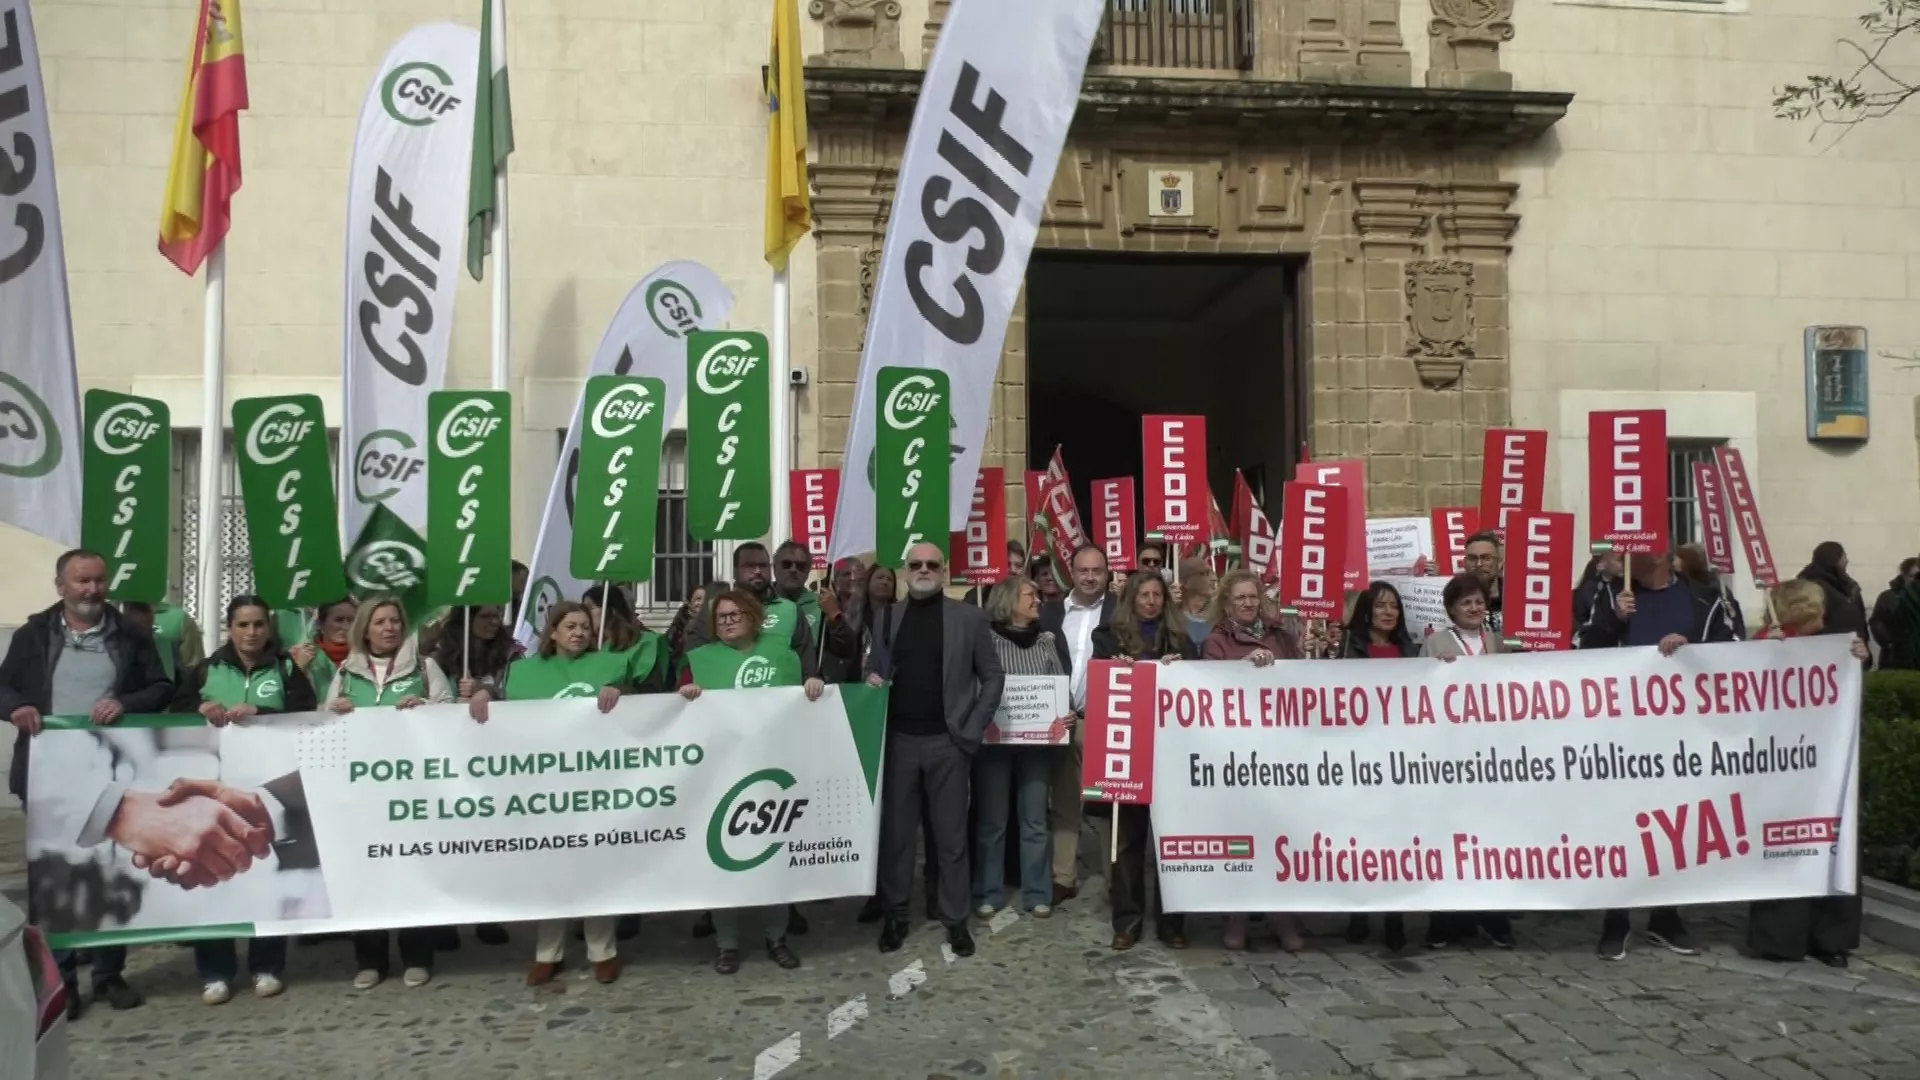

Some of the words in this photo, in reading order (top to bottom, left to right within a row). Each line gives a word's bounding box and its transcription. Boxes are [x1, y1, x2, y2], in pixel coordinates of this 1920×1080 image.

[397, 77, 461, 115] CSIF
[904, 60, 1033, 345] CSIF
[359, 165, 442, 386] CSIF
[708, 356, 759, 377] CSIF
[604, 399, 655, 420] CSIF
[895, 391, 942, 412] CSIF
[107, 417, 160, 441] CSIF
[259, 420, 314, 445] CSIF
[450, 417, 501, 438] CSIF
[359, 450, 424, 482] CSIF
[714, 402, 742, 532] CSIF
[1163, 421, 1187, 522] CCOO
[1614, 417, 1641, 530] CCOO
[596, 446, 633, 571] CSIF
[805, 473, 827, 554] CCOO
[1104, 483, 1122, 558] CCOO
[1701, 469, 1725, 556] CCOO
[1725, 455, 1767, 566] CCOO
[109, 465, 141, 591] CSIF
[276, 470, 312, 600] CSIF
[455, 465, 483, 596] CSIF
[1301, 489, 1326, 598] CCOO
[1604, 532, 1657, 541] universidad
[1525, 518, 1551, 628] CCOO
[1291, 599, 1335, 608] universidad
[1514, 630, 1562, 639] universidad
[743, 667, 776, 685] CSIF
[1156, 688, 1215, 727] POR
[1223, 688, 1251, 727] EL
[1260, 686, 1369, 727] EMPLEO
[1376, 686, 1392, 725] Y
[1401, 685, 1436, 725] LA
[1443, 679, 1571, 723] CALIDAD
[1581, 676, 1621, 718] DE
[1631, 673, 1686, 717] LOS
[1695, 663, 1838, 715] SERVICIOS
[1105, 667, 1132, 779] CCOO
[350, 760, 413, 783] POR
[424, 757, 459, 780] EL
[467, 743, 704, 778] CUMPLIMIENTO
[1189, 753, 1215, 787] En
[1223, 750, 1310, 787] defensa
[1317, 750, 1344, 786] de
[1350, 749, 1383, 786] las
[1390, 745, 1555, 785] Universidades
[1563, 741, 1665, 780] Públicas
[1673, 740, 1703, 777] de
[1710, 734, 1817, 776] Andalucía
[388, 799, 428, 821] DE
[437, 796, 495, 819] LOS
[504, 785, 678, 816] ACUERDOS
[1094, 780, 1144, 790] universidad
[728, 798, 808, 836] CSIF
[1767, 823, 1827, 842] CCOO
[367, 844, 393, 858] EN
[399, 842, 433, 856] LAS
[439, 833, 588, 855] UNIVERSIDADES
[594, 827, 686, 846] PÚBLICAS
[788, 837, 852, 853] Educación
[1163, 841, 1224, 856] CCOO
[1274, 831, 1444, 882] Suficiencia
[1453, 832, 1627, 881] Financiera
[1635, 792, 1750, 877] ¡YA!
[1763, 848, 1819, 860] Enseñanza
[789, 851, 860, 868] Andalucía
[1161, 862, 1215, 873] Enseñanza
[1223, 860, 1253, 872] Cádiz
